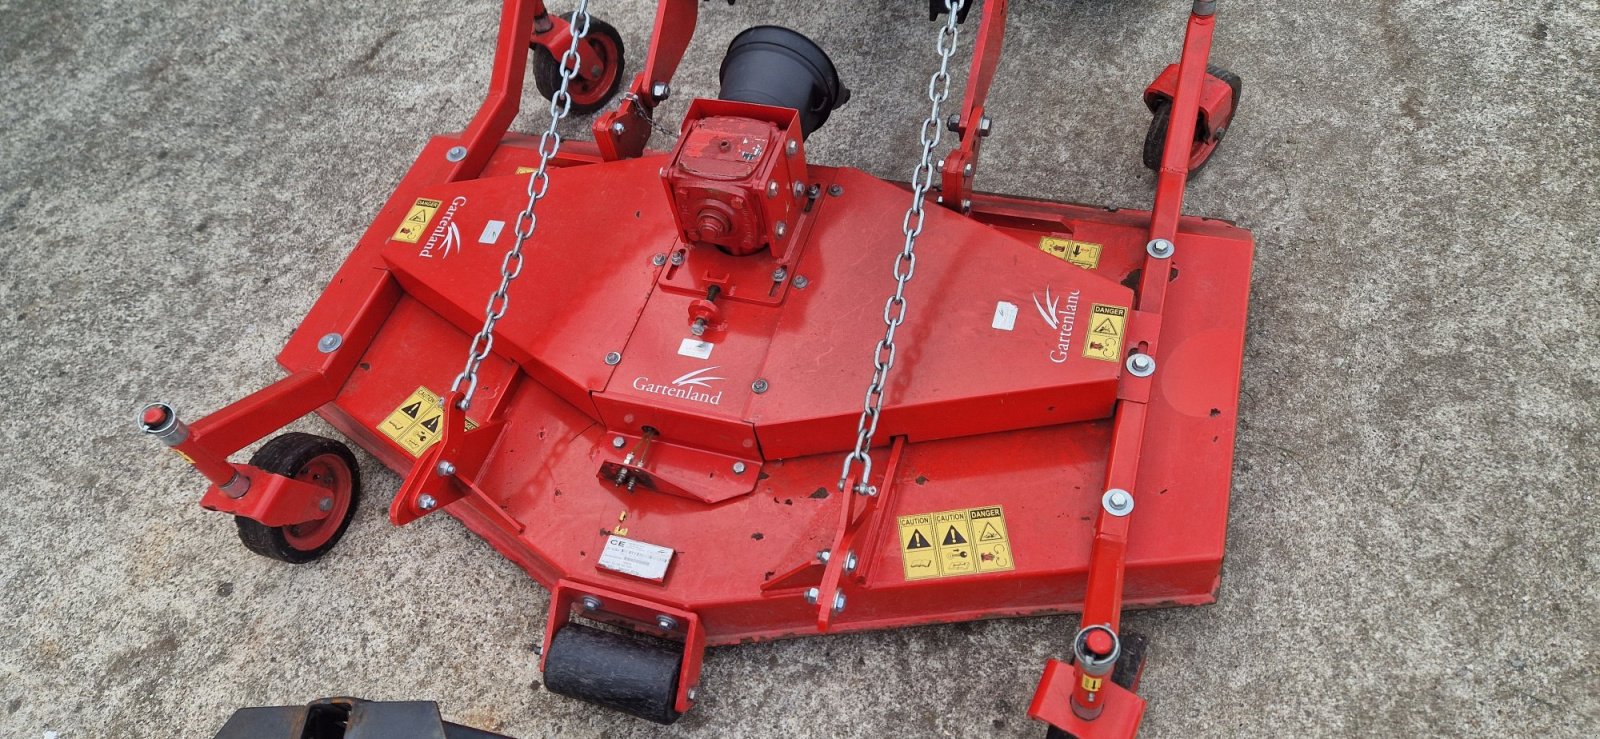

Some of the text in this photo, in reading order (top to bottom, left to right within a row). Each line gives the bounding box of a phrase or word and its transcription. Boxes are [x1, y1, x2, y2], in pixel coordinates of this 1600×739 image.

[417, 200, 440, 208] DANGER
[419, 196, 466, 257] Gartenland
[1095, 305, 1124, 315] DANGER
[633, 376, 722, 405] Gartenland
[937, 513, 964, 522] CAUTION
[971, 508, 1000, 519] DANGER
[901, 517, 928, 525] CAUTION
[610, 539, 626, 547] CE
